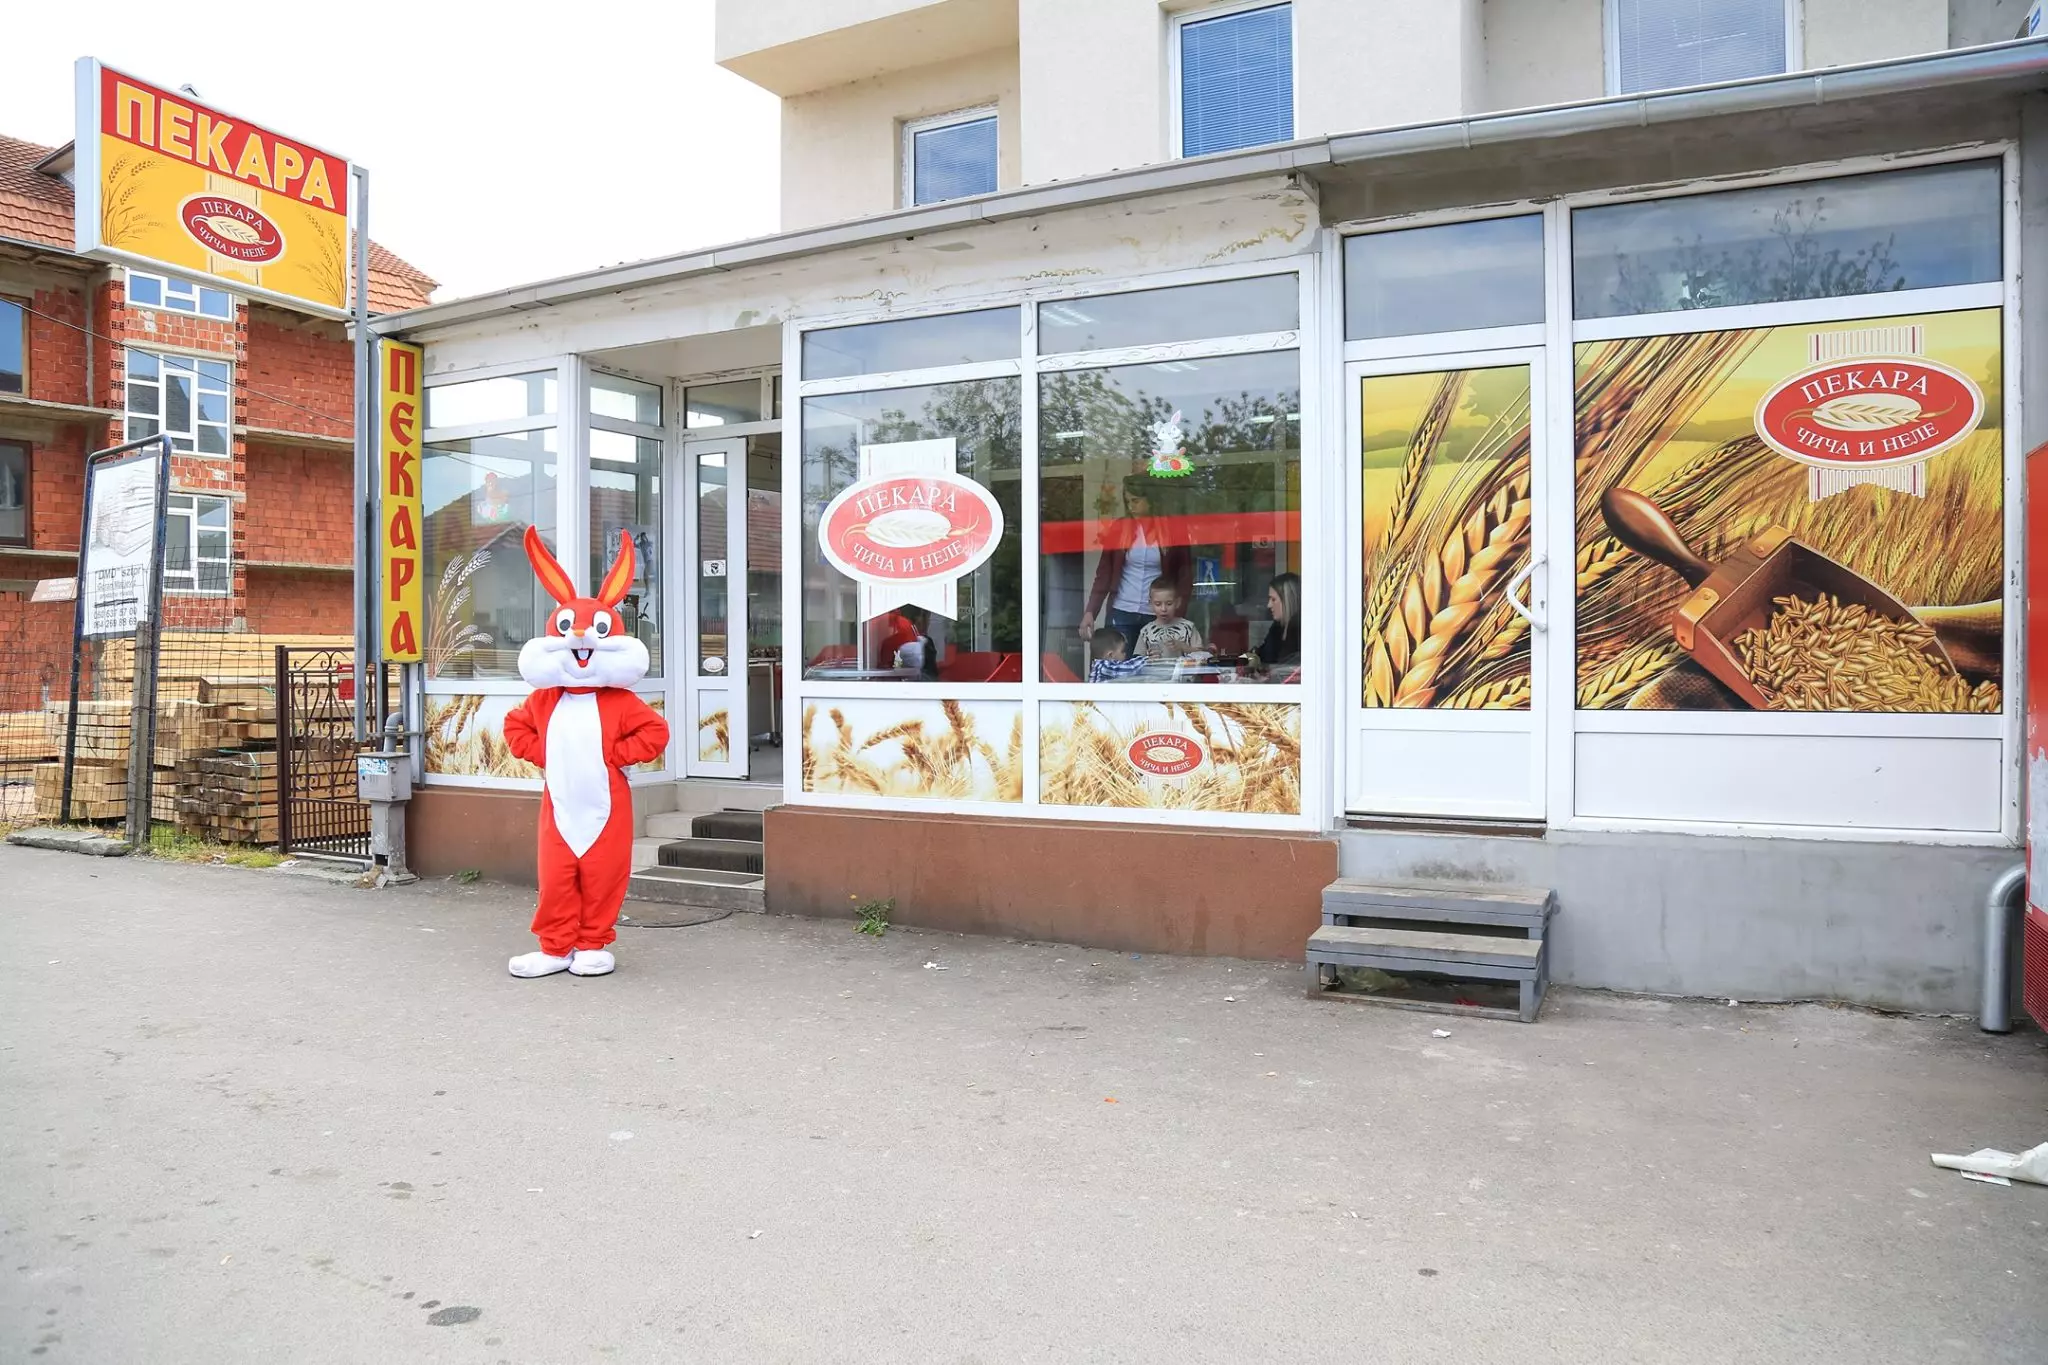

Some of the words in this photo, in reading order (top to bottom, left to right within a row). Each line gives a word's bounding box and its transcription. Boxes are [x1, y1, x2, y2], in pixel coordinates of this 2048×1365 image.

[116, 81, 335, 209] ПЕКАРА
[200, 200, 264, 232] ПЕКАРА
[199, 226, 227, 252] ЧИЧА
[230, 247, 240, 256] И
[241, 247, 268, 257] НЕЛЕ
[1800, 370, 1928, 403] ПЕКАРА
[1797, 426, 1850, 456] ЧИЧА
[1858, 441, 1874, 456] И
[1881, 422, 1939, 453] НЕЛЕ
[389, 347, 417, 655] ПЕКАРА
[856, 485, 957, 518] ПЕКАРА
[853, 543, 895, 573] ЧИЧА
[902, 558, 915, 573] И
[920, 540, 965, 570] НЕЛЕ
[1141, 736, 1188, 750] ПЕКАРА
[1140, 758, 1160, 773] ЧИЧА
[1162, 765, 1169, 773] И
[1170, 760, 1191, 773] НЕЛЕ
